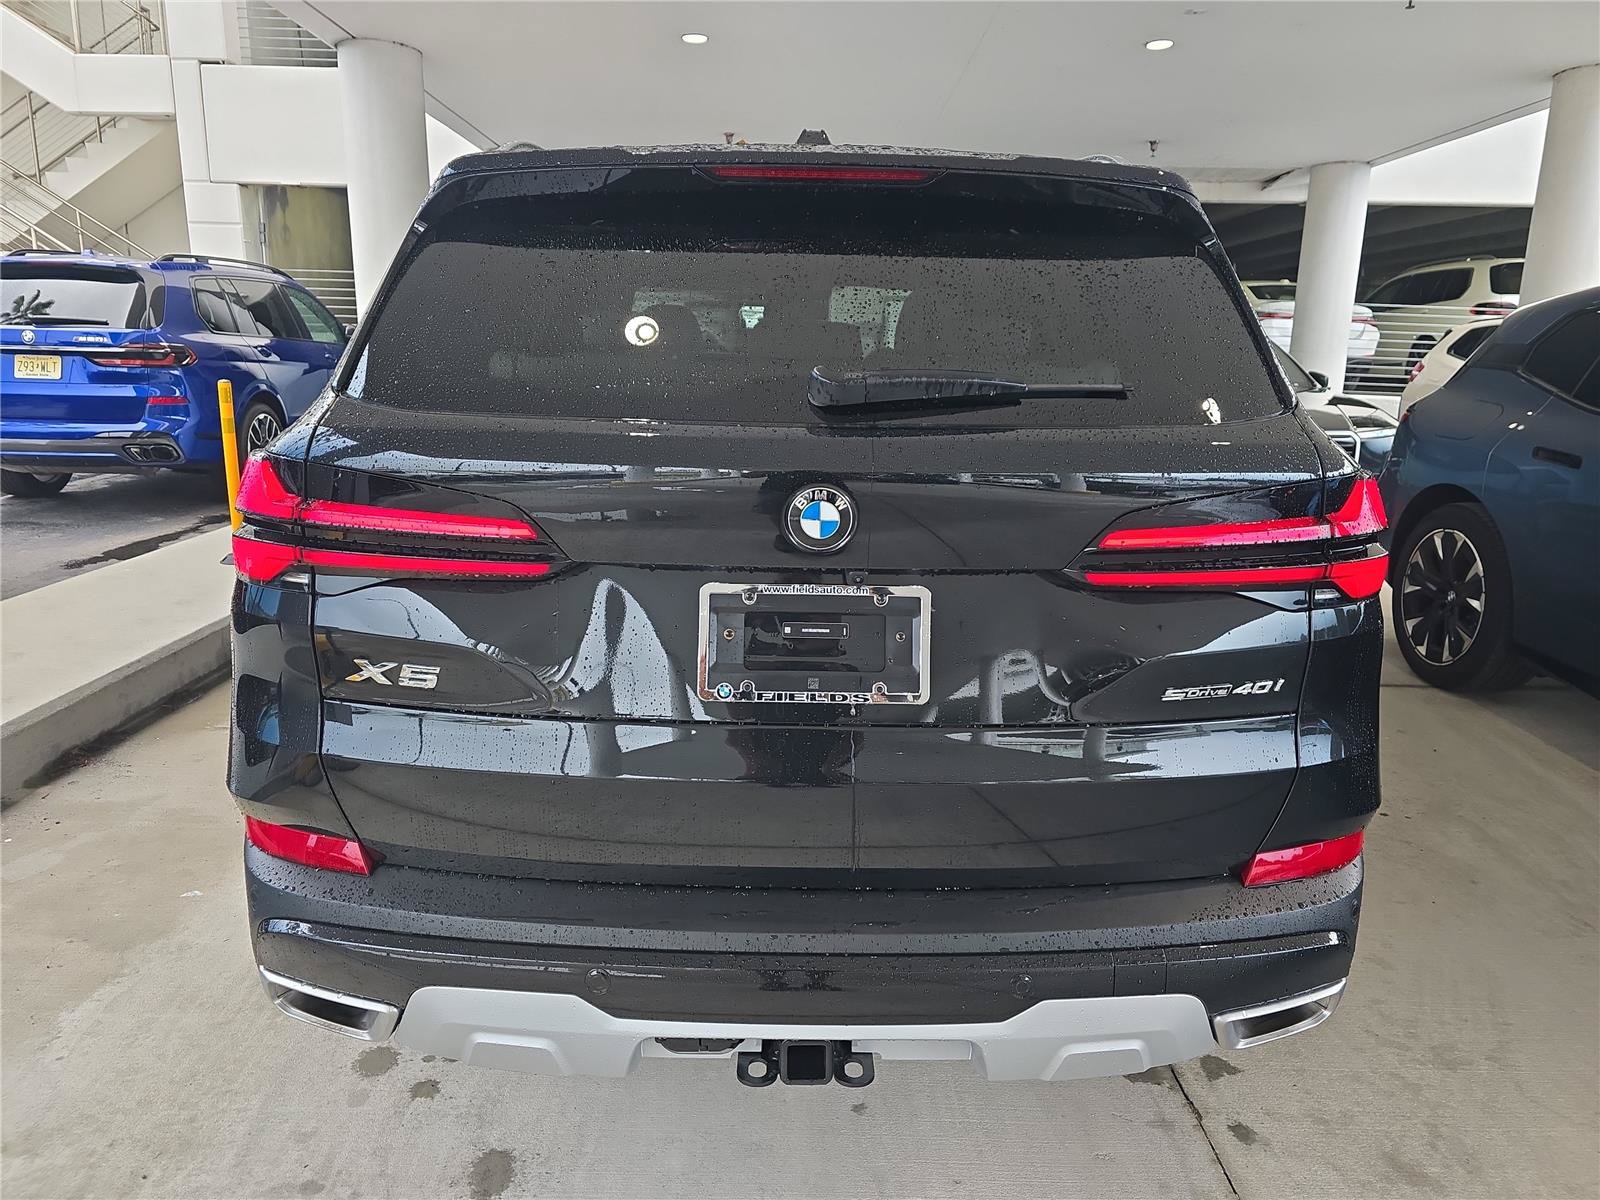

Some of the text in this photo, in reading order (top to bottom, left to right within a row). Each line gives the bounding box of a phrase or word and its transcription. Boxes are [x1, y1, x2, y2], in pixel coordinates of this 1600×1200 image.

[794, 489, 848, 511] BMW
[762, 584, 870, 595] www.fieldsauto.com
[344, 658, 442, 689] X5
[756, 692, 871, 703] FIELDS
